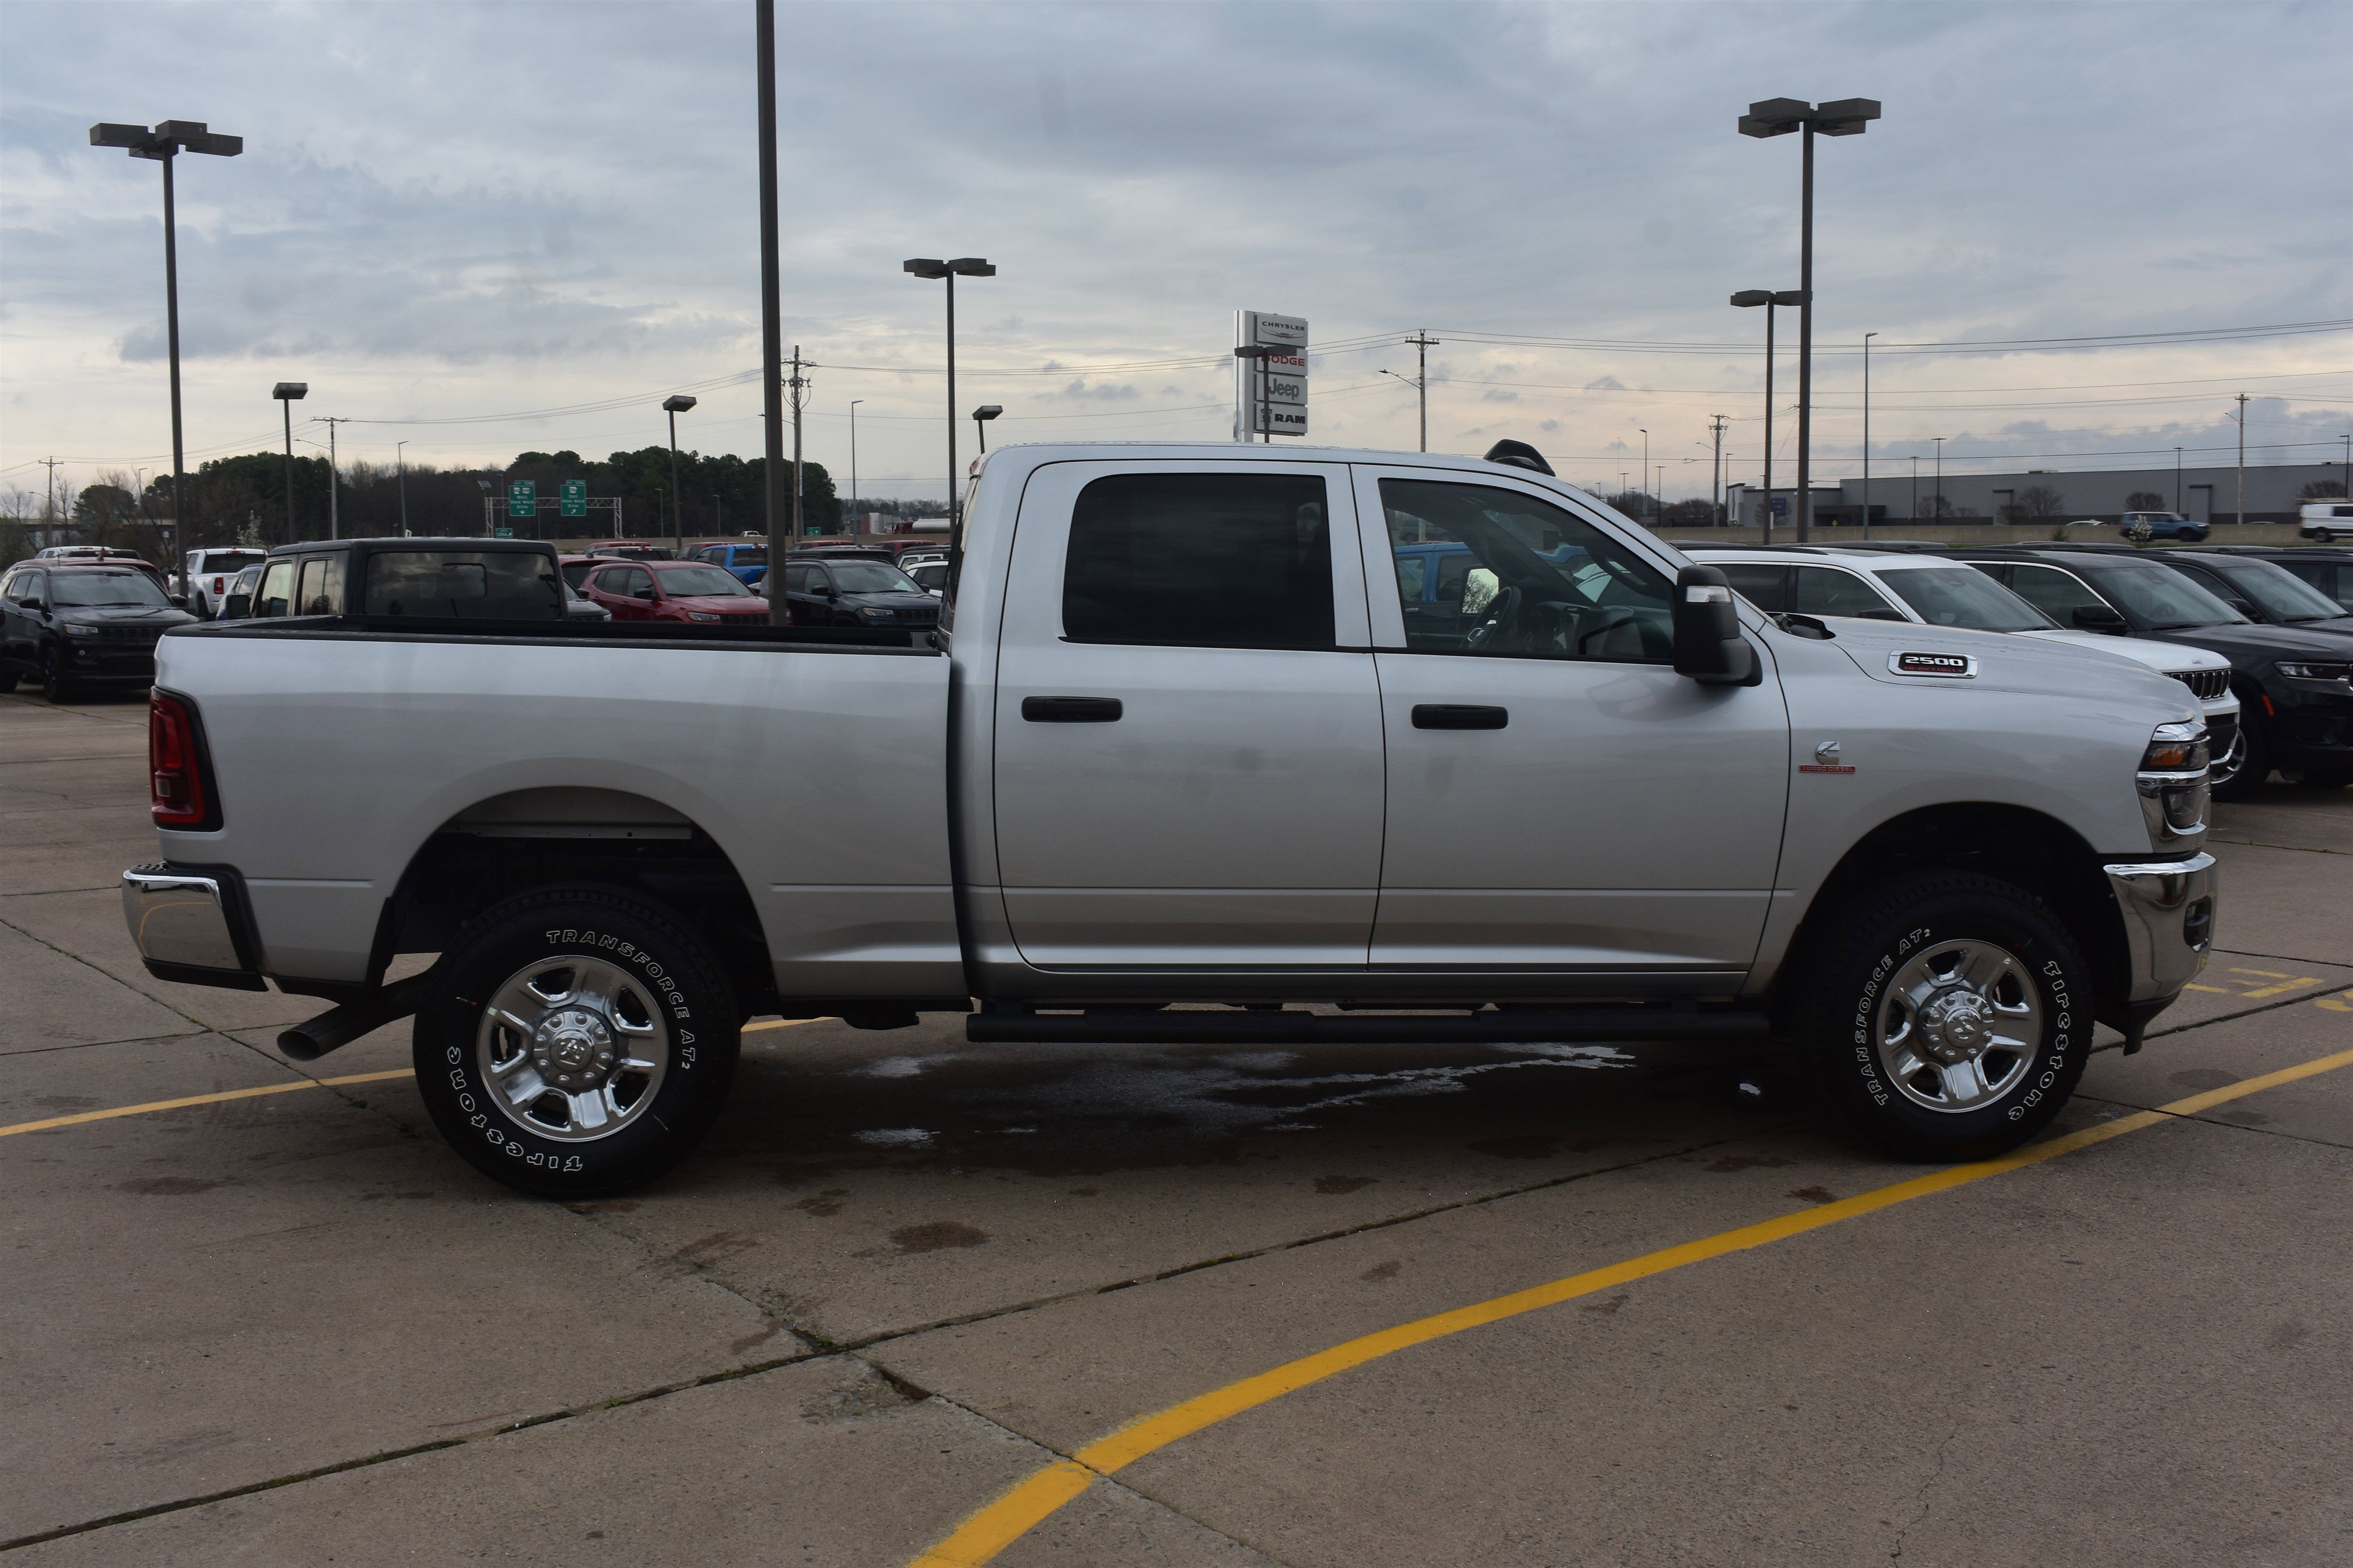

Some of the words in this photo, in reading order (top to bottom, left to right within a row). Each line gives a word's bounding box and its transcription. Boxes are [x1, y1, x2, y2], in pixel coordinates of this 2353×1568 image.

[1262, 321, 1305, 331] CHRYSLER
[1268, 378, 1299, 400] Jeep
[1275, 413, 1306, 424] RAM
[1904, 656, 1964, 666] 2500
[546, 929, 690, 1019] TRANSFORCE
[1855, 954, 1893, 1106] TRANSFORCE
